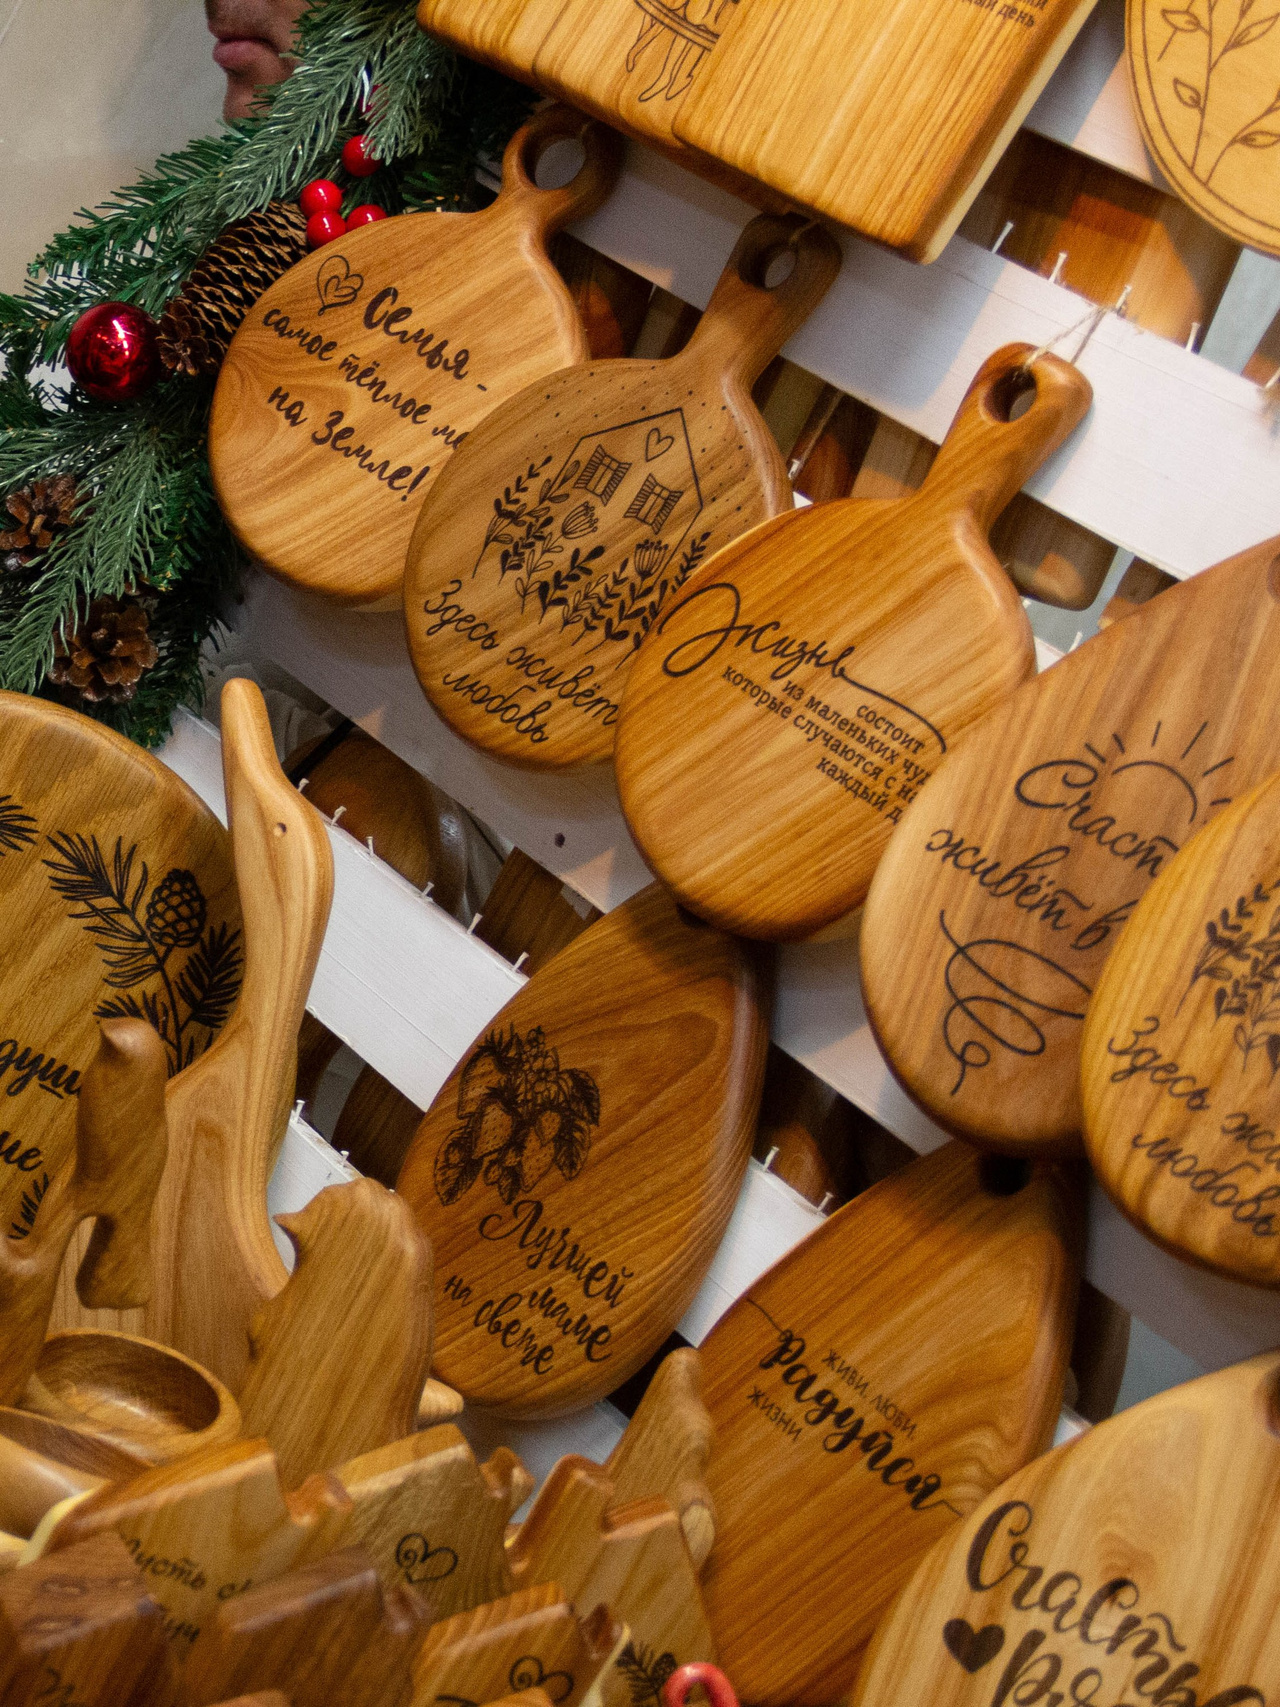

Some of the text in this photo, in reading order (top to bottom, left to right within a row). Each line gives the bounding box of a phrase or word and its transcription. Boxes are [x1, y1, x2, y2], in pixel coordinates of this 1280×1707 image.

[262, 308, 337, 361] самое
[338, 353, 432, 425] тёплое
[363, 286, 470, 380] Семья
[267, 386, 430, 502] на Земле!
[424, 579, 620, 726] Здесь живёт
[442, 673, 552, 743] любовь
[721, 664, 792, 720] которые
[792, 712, 884, 781] случаются
[883, 776, 898, 790] с
[782, 681, 803, 701] из
[805, 696, 901, 765] маленьких
[856, 705, 925, 755] состоит
[816, 756, 889, 813] каждый
[925, 828, 1094, 932] живёт
[1106, 1015, 1211, 1112] Здесь
[1131, 1133, 1280, 1238] любовь
[478, 1199, 635, 1309] Лучшей
[443, 1274, 556, 1376] на свете
[527, 1287, 614, 1364] маме
[747, 1385, 804, 1443] ЖИЗНИ
[870, 1394, 918, 1440] ЛЮБИ
